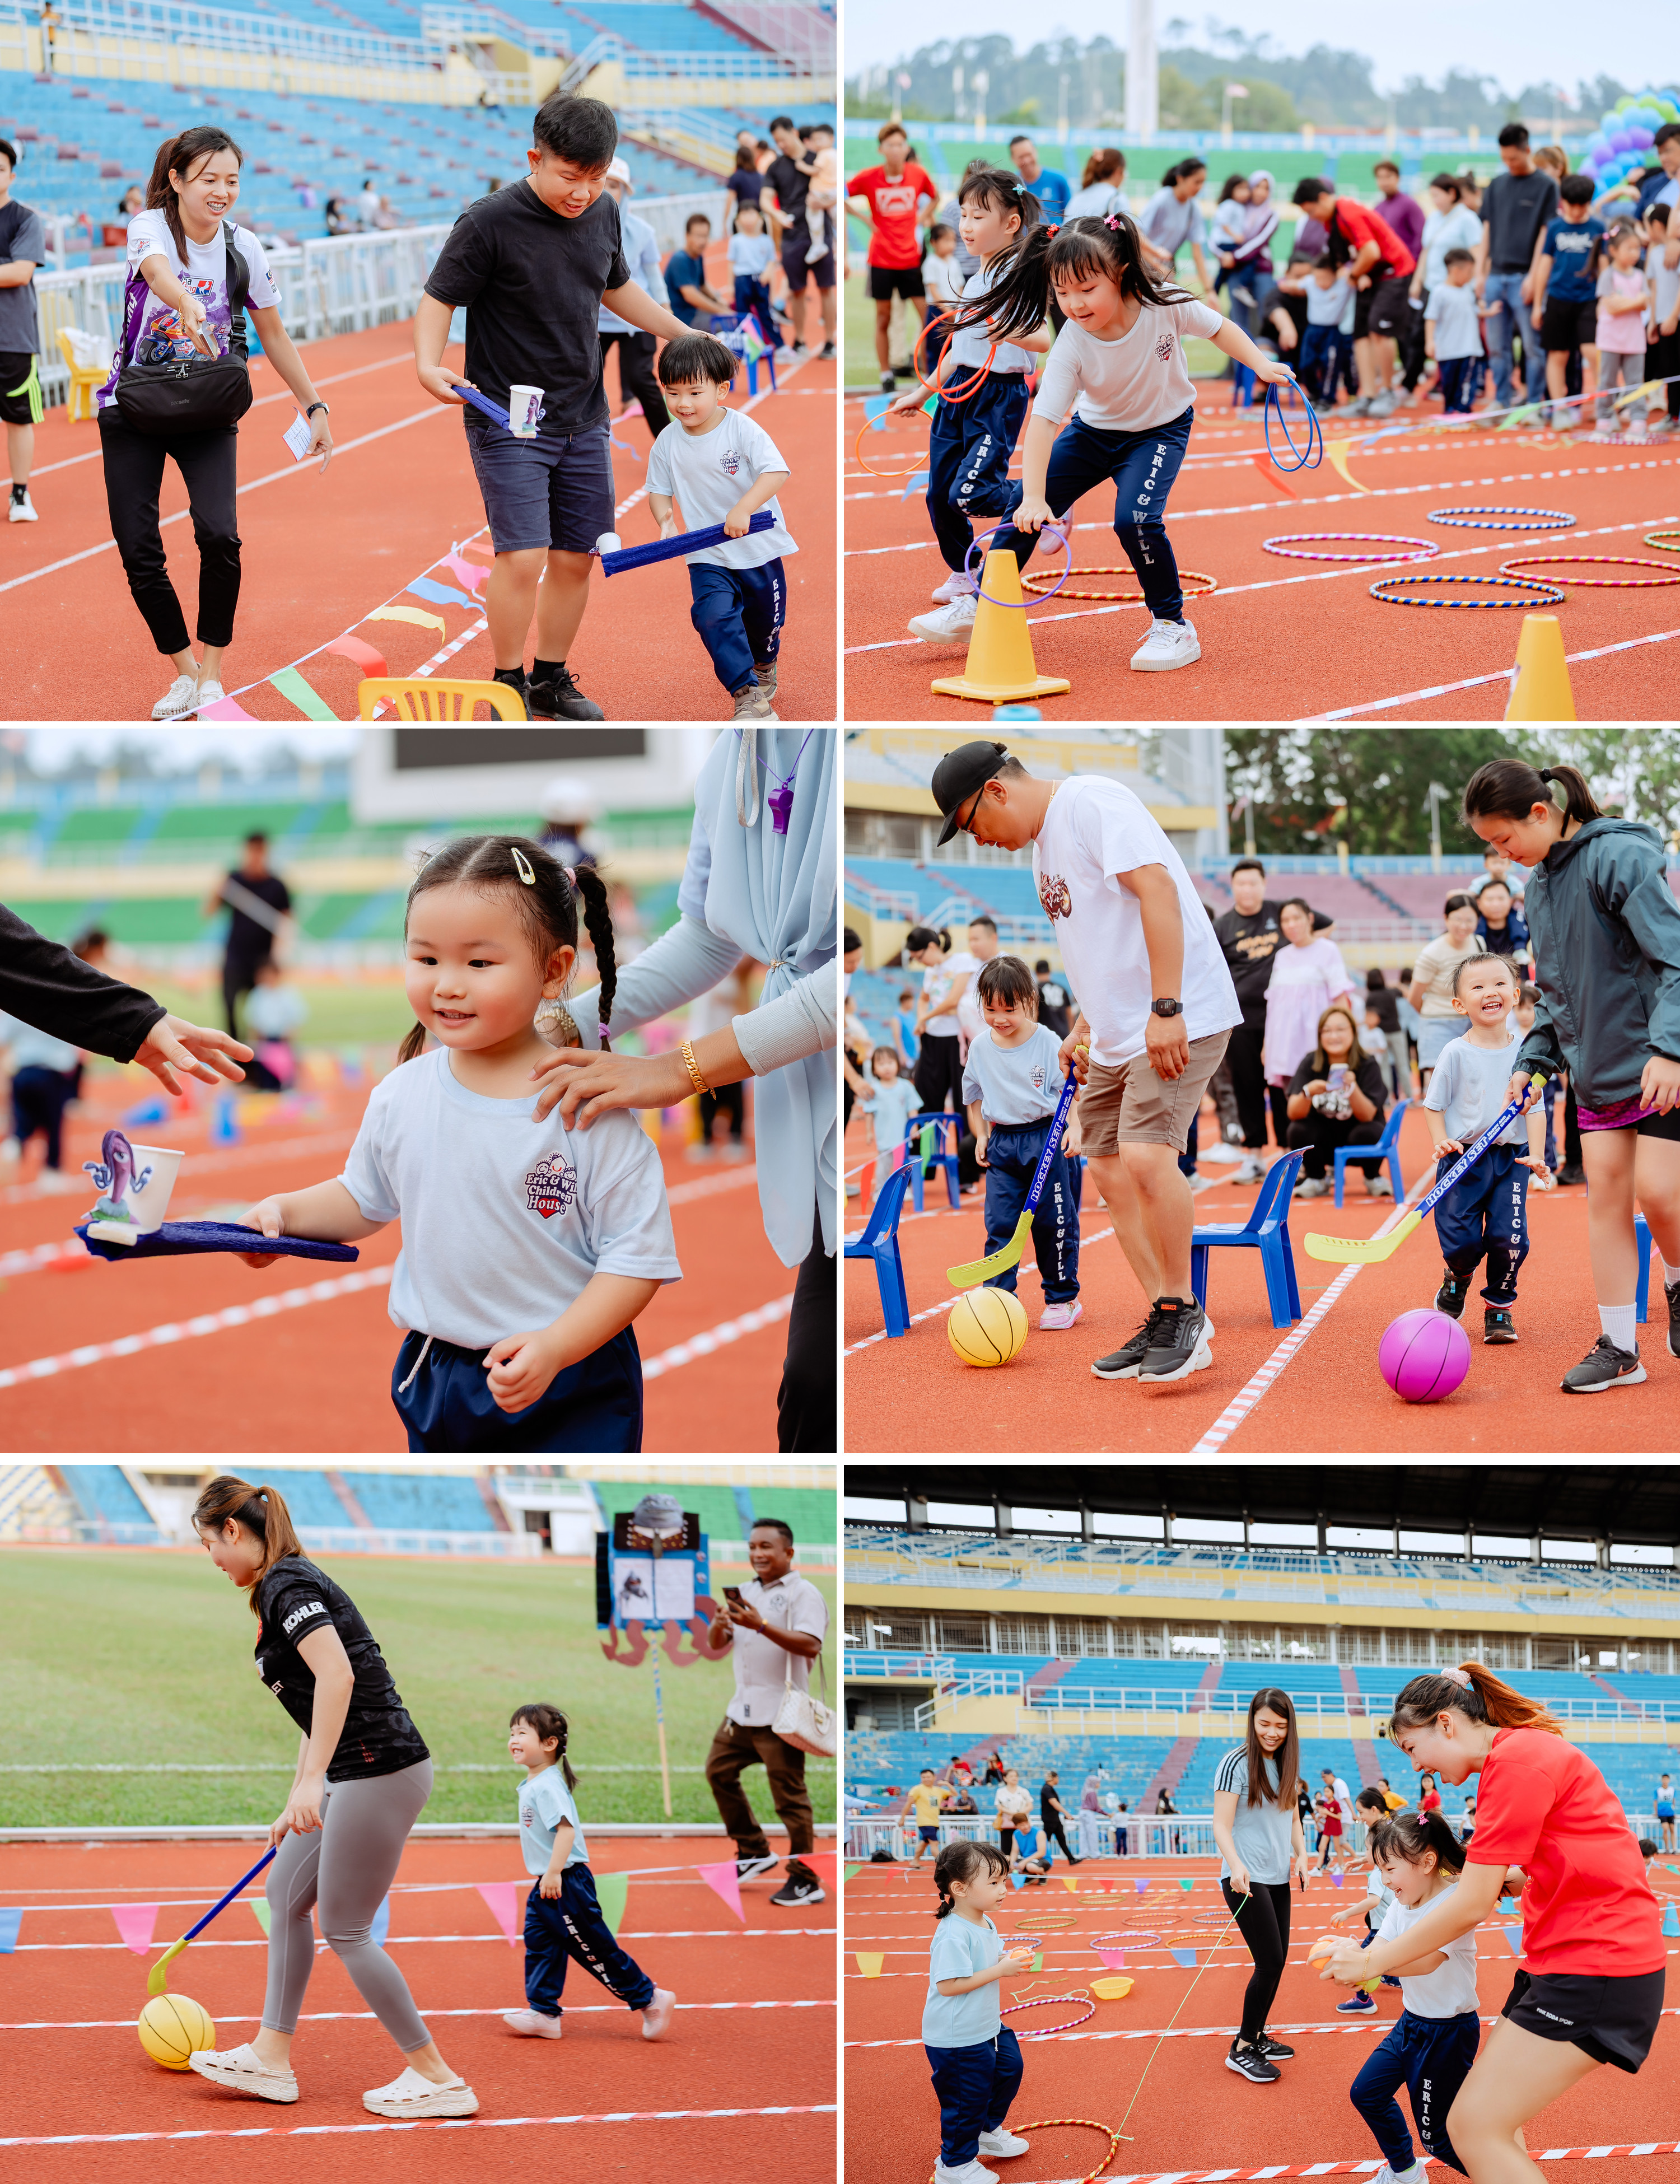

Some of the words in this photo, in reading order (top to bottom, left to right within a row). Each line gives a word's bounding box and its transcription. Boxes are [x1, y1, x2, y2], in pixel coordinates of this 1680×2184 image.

[967, 434, 992, 480] ERIC
[1144, 444, 1166, 490] ERIC
[960, 483, 974, 494] &
[1137, 493, 1151, 506] &
[1132, 510, 1154, 564] WILL
[772, 578, 781, 623] ERIC
[1487, 1123, 1499, 1137] HAPPY
[525, 1174, 548, 1185] Eric
[549, 1175, 561, 1186] &
[1030, 1148, 1053, 1202] HOCKEY
[1049, 1122, 1063, 1149] SET
[1425, 1158, 1468, 1207] HOCKEY
[1467, 1136, 1488, 1162] SET
[528, 1185, 572, 1203] Children
[528, 1196, 566, 1215] House
[1054, 1182, 1063, 1225] ERIC
[1512, 1182, 1522, 1229] ERIC
[1057, 1229, 1065, 1238] &
[1510, 1234, 1521, 1244] &
[1056, 1240, 1066, 1281] WILL
[1500, 1249, 1520, 1290] WILL
[282, 1601, 326, 1634] KOHLER
[562, 1915, 590, 1952] ERIC
[592, 1963, 625, 1996] WILL
[1536, 2007, 1547, 2015] PINK
[1546, 2012, 1558, 2021] SODA
[1558, 2017, 1575, 2026] SPORT
[1422, 2079, 1432, 2127] ERIC
[1422, 2130, 1431, 2140] &
